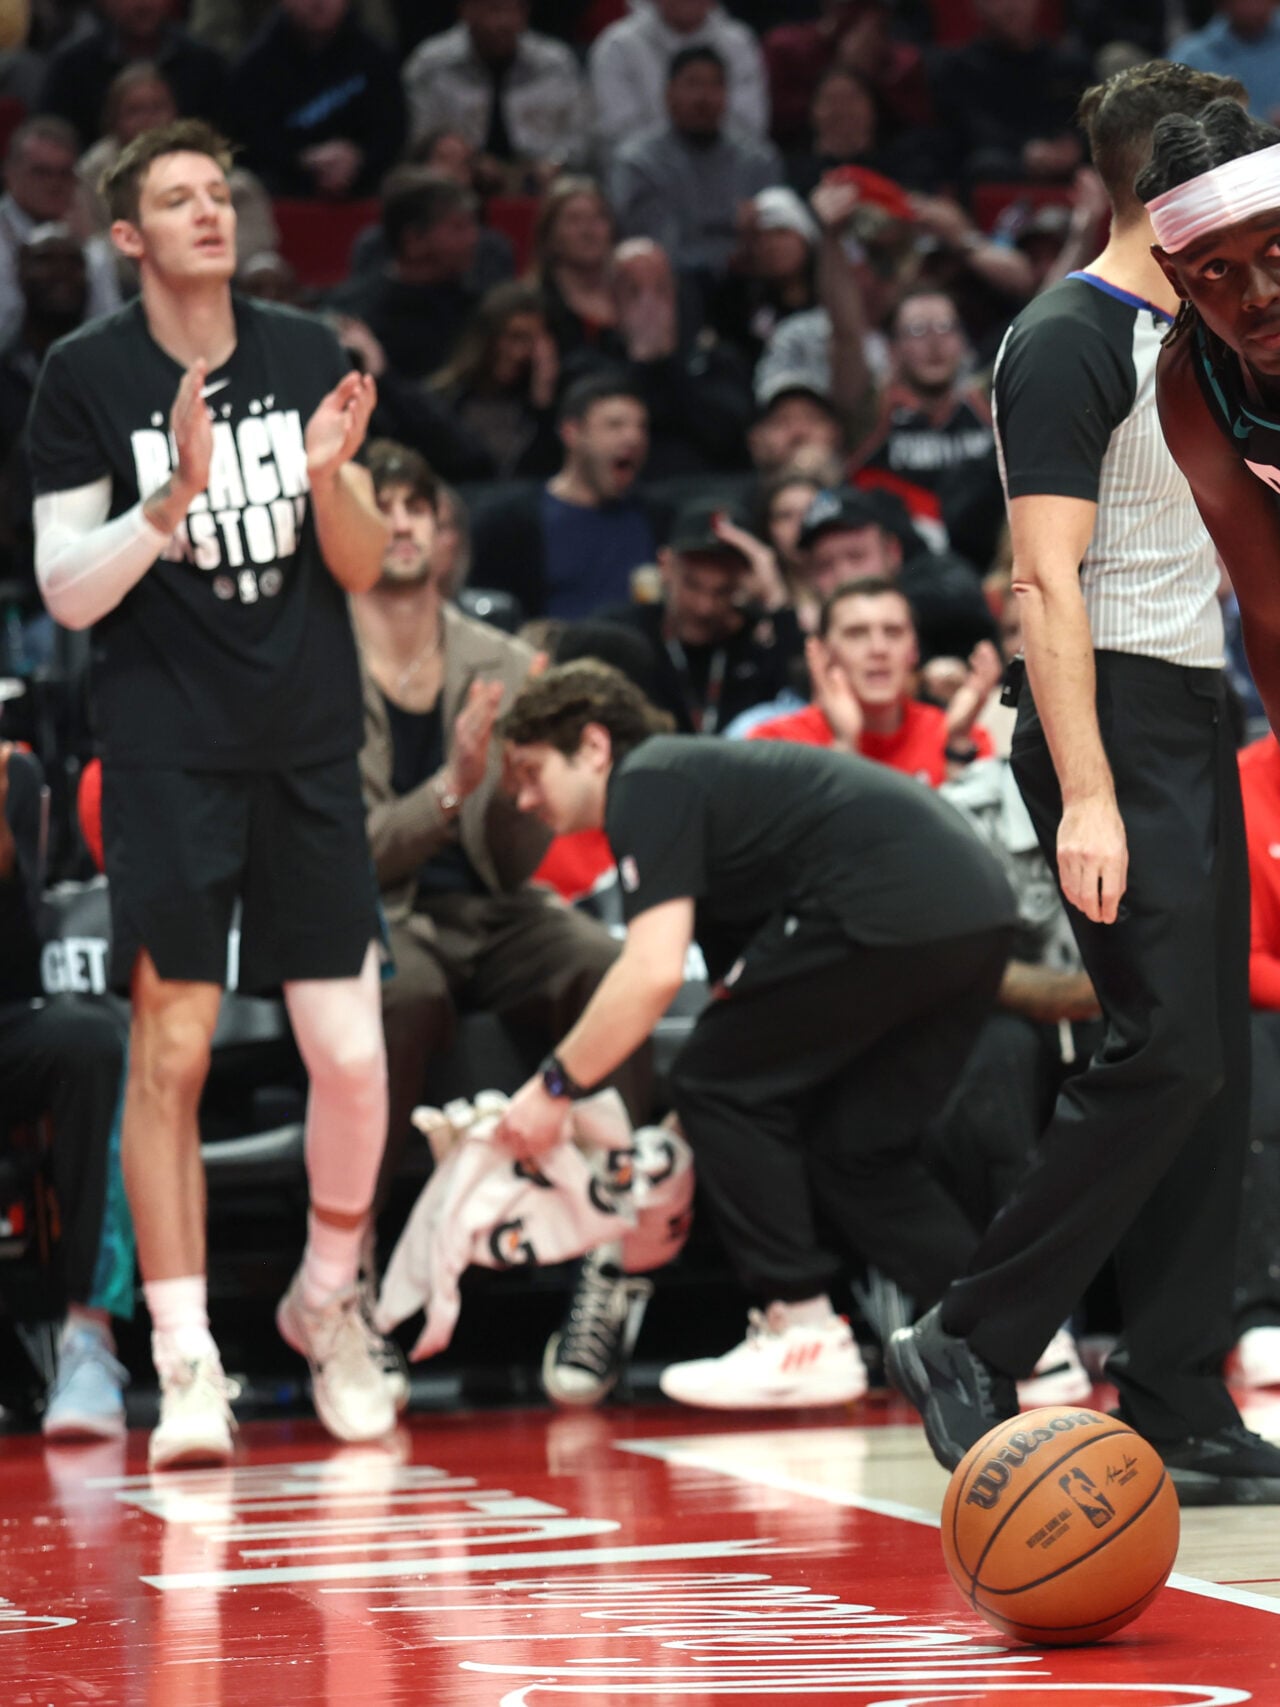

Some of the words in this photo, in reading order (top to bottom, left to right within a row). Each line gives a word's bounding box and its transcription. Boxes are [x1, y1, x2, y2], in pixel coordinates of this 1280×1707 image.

[131, 409, 310, 512] BACK
[42, 937, 108, 995] GET
[966, 1412, 1104, 1509] Wilson
